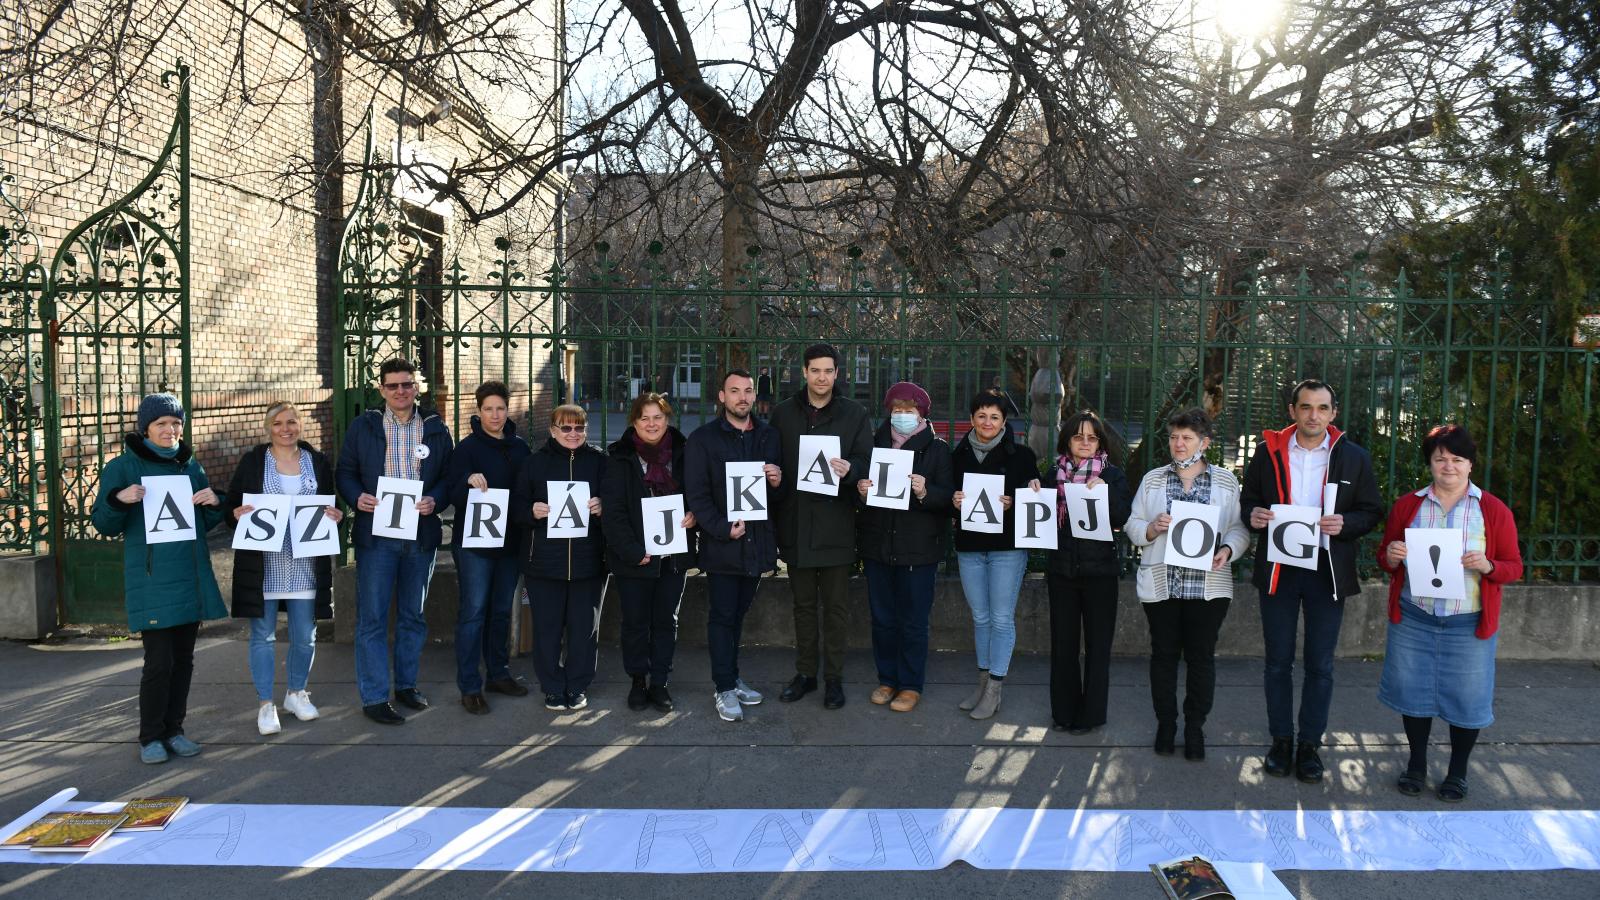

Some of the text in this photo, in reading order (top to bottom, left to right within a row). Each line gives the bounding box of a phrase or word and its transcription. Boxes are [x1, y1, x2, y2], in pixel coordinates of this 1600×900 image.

[802, 450, 837, 486] A
[873, 462, 906, 499] L
[382, 492, 416, 530] T
[551, 484, 587, 529] Á
[731, 476, 766, 511] K
[964, 488, 1001, 524] A
[150, 492, 192, 533] A
[245, 508, 278, 541] S
[469, 503, 503, 538] R
[653, 509, 674, 546] J
[1022, 502, 1052, 539] P
[1078, 498, 1100, 532] J
[1171, 517, 1215, 558] O
[1273, 520, 1317, 559] G
